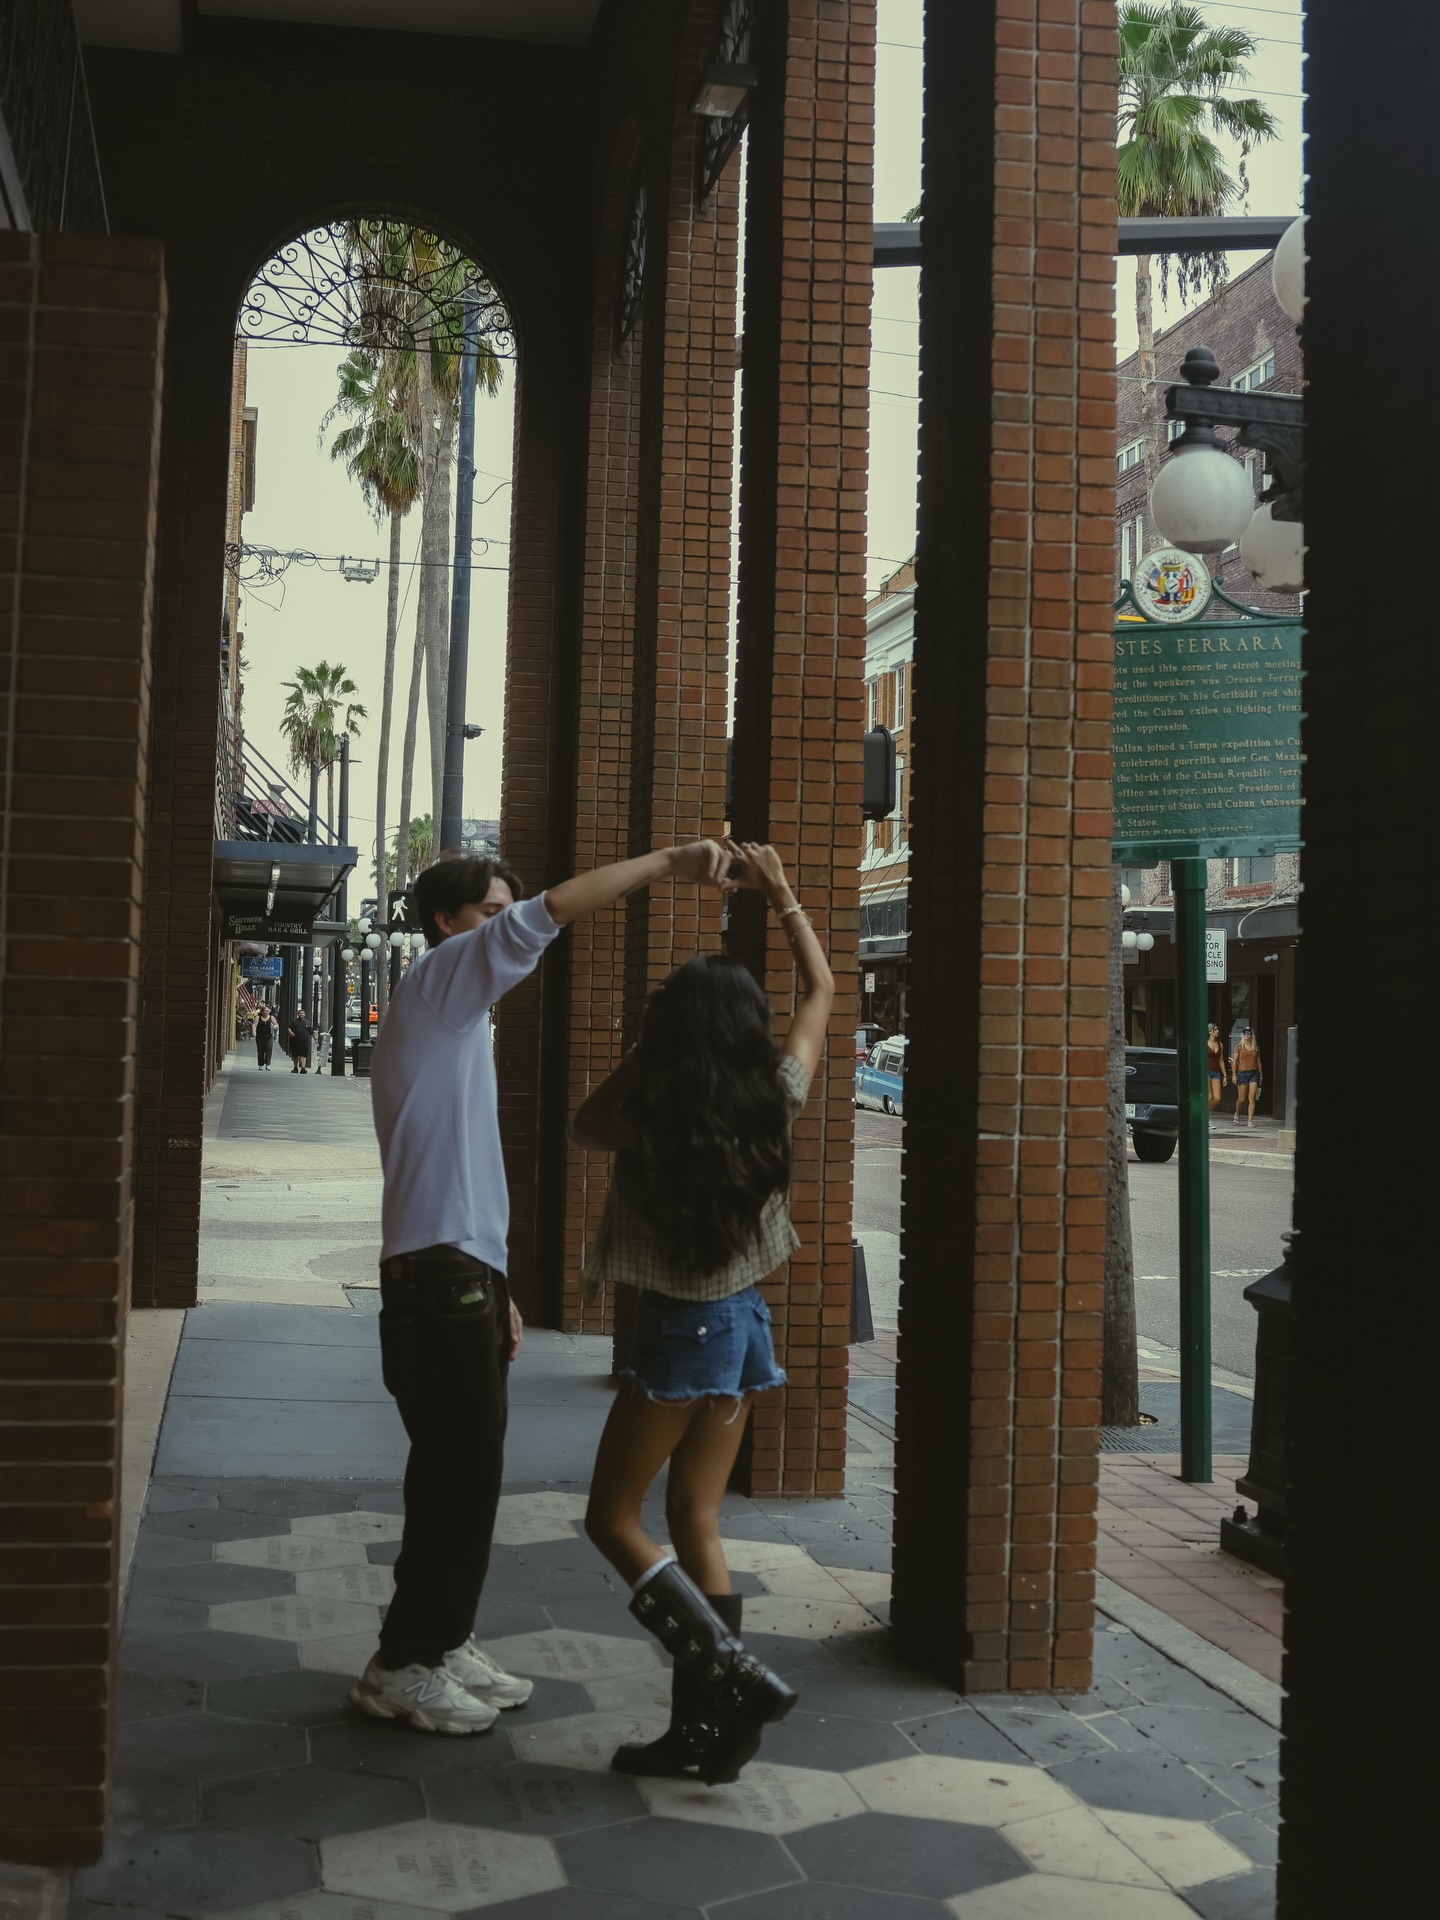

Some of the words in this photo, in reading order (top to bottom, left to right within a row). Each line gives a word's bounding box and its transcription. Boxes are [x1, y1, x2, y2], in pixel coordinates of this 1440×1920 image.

[1115, 639, 1162, 656] STES
[1176, 635, 1284, 654] FERRARA
[1132, 664, 1154, 673] used
[1159, 663, 1178, 673] this
[1182, 663, 1212, 672] corner
[1215, 661, 1228, 670] for
[1231, 661, 1260, 670] street
[1264, 659, 1302, 669] meeting
[1132, 679, 1148, 688] the
[1152, 677, 1196, 689] speakers
[1202, 678, 1220, 686] was
[1226, 675, 1263, 685] Orestes
[1193, 691, 1209, 701] his
[1212, 689, 1258, 700] Garibaldi
[1262, 688, 1278, 698] red
[1282, 688, 1303, 697] shir
[1133, 708, 1149, 718] the
[1153, 707, 1184, 717] Cuban
[1189, 706, 1218, 716] exiles
[1222, 705, 1232, 714] to
[1236, 703, 1271, 714] fighting
[1277, 703, 1302, 712] frenz
[1136, 723, 1191, 734] oppression.
[1147, 742, 1175, 753] joined
[1188, 739, 1218, 751] Tampa
[1221, 738, 1272, 750] expedition
[1275, 738, 1285, 747] to
[1287, 736, 1302, 746] Cu
[1120, 757, 1169, 768] celebrated
[1173, 755, 1216, 768] guerrilla
[1220, 754, 1247, 764] under
[1275, 751, 1308, 761] Maxim
[1117, 773, 1132, 783] the
[1135, 772, 1159, 782] birth
[1163, 771, 1172, 781] of
[1176, 770, 1191, 780] the
[1194, 769, 1224, 780] Cuban
[1117, 787, 1144, 798] office
[1148, 788, 1159, 797] as
[1239, 782, 1284, 794] President
[1287, 781, 1297, 791] of
[1120, 803, 1166, 815] Secretary
[1168, 801, 1177, 811] of
[1206, 799, 1223, 809] and
[1225, 797, 1256, 808] Cuban
[1259, 796, 1307, 807] Ambassad
[1127, 817, 1159, 827] States.
[1205, 942, 1219, 950] TOR
[1205, 951, 1222, 959] ICLE
[1206, 960, 1224, 968] SING
